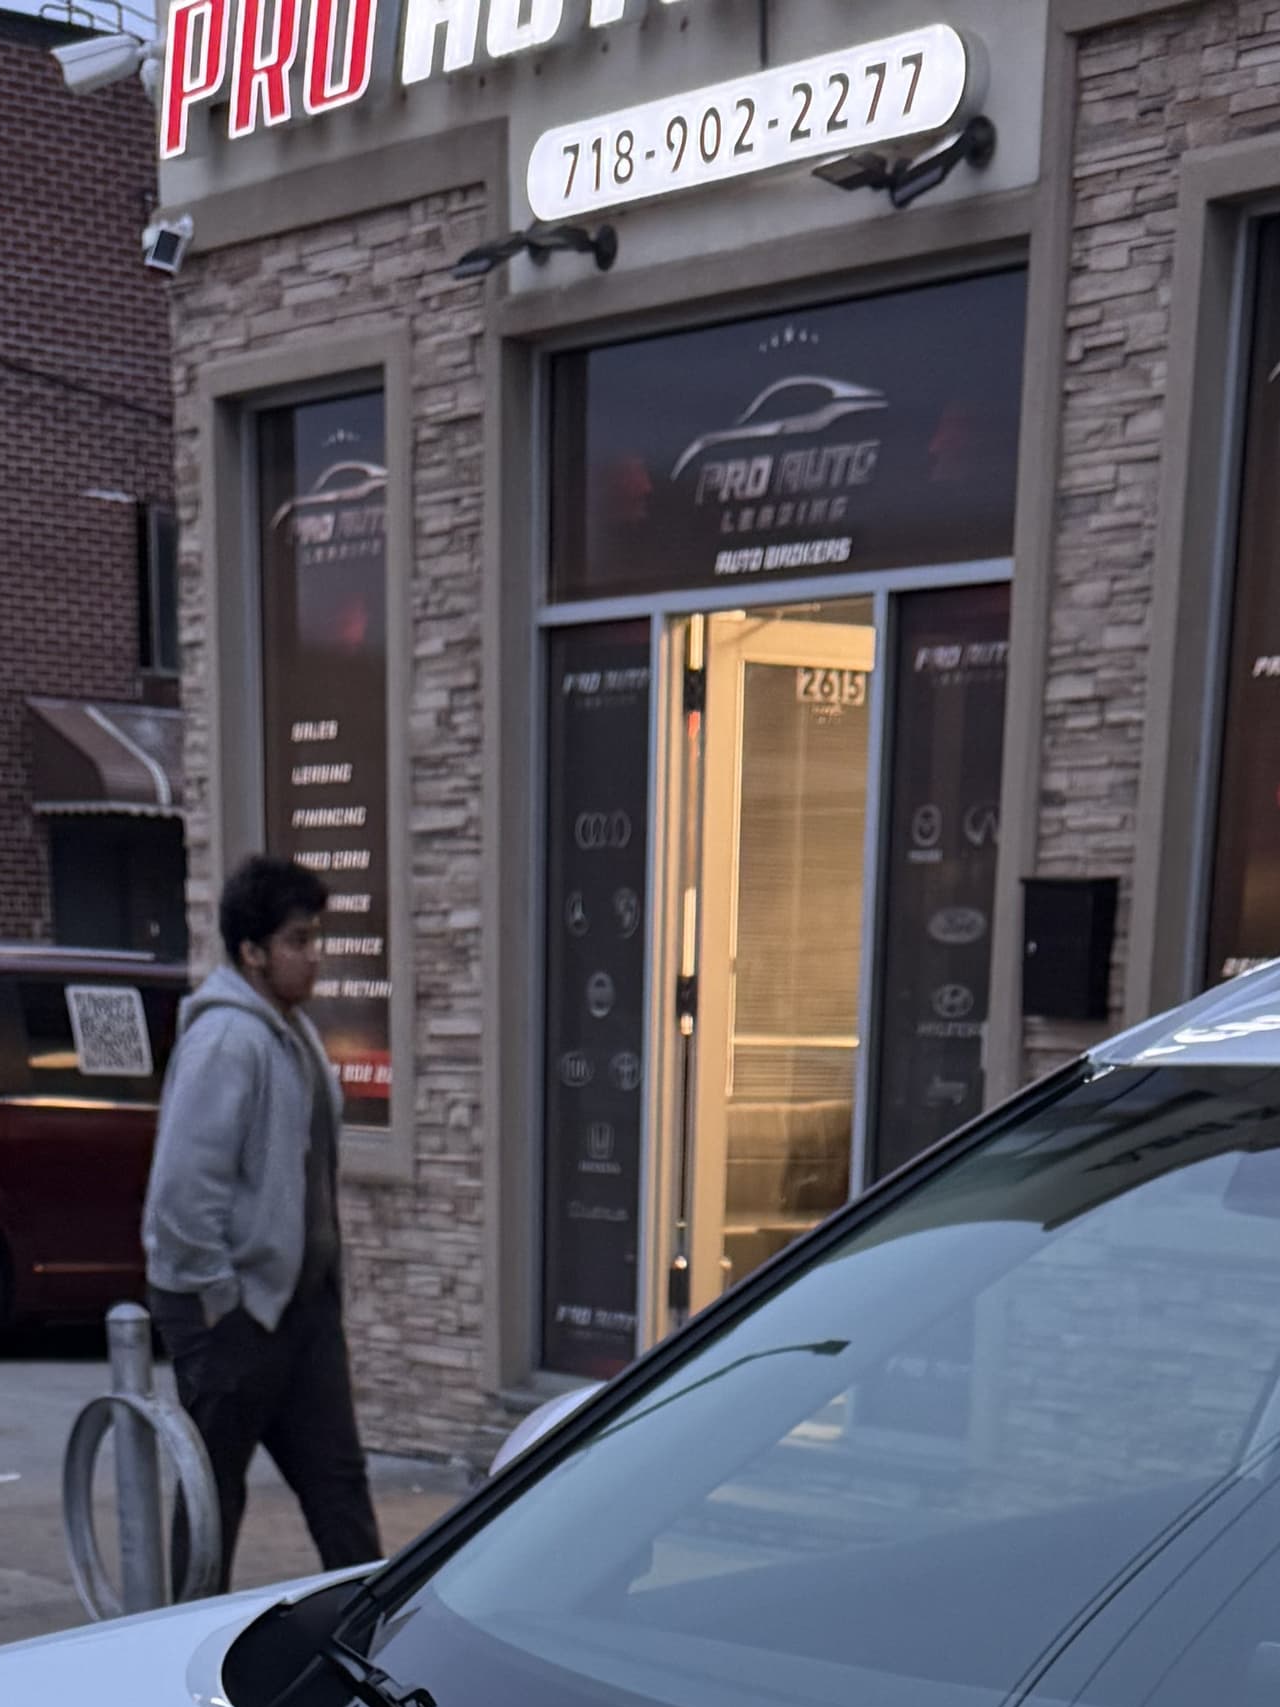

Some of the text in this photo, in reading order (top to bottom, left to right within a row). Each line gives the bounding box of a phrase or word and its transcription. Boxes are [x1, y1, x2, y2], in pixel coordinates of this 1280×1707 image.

[159, 0, 376, 160] PRO
[562, 51, 925, 199] 718-902-2277
[695, 454, 774, 506] PRO
[714, 536, 853, 577] AUTO BROKERS
[802, 668, 862, 699] 2615
[324, 936, 384, 956] SERVICE
